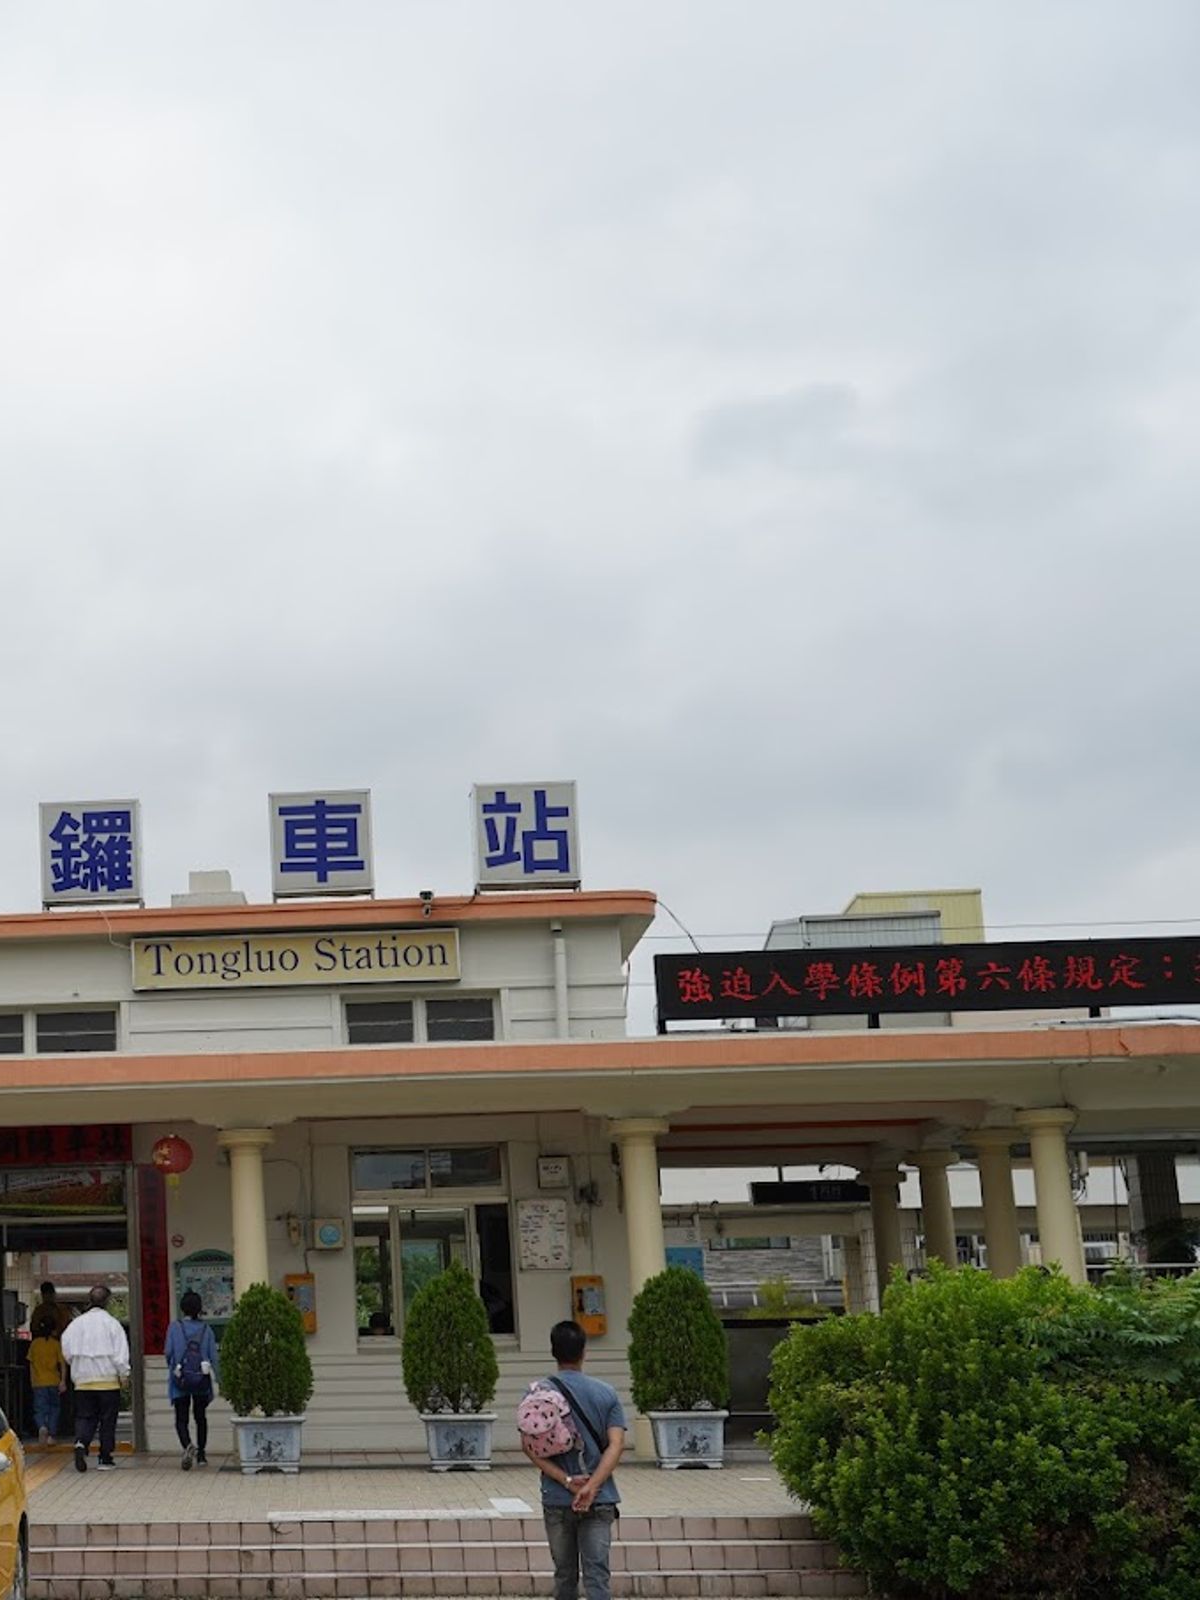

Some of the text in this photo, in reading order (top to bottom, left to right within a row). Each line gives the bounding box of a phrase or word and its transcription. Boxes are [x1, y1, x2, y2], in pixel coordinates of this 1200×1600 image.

[144, 936, 449, 980] Tongluo Station
[676, 953, 1200, 1004] 強迫入學條例第六條規定：
